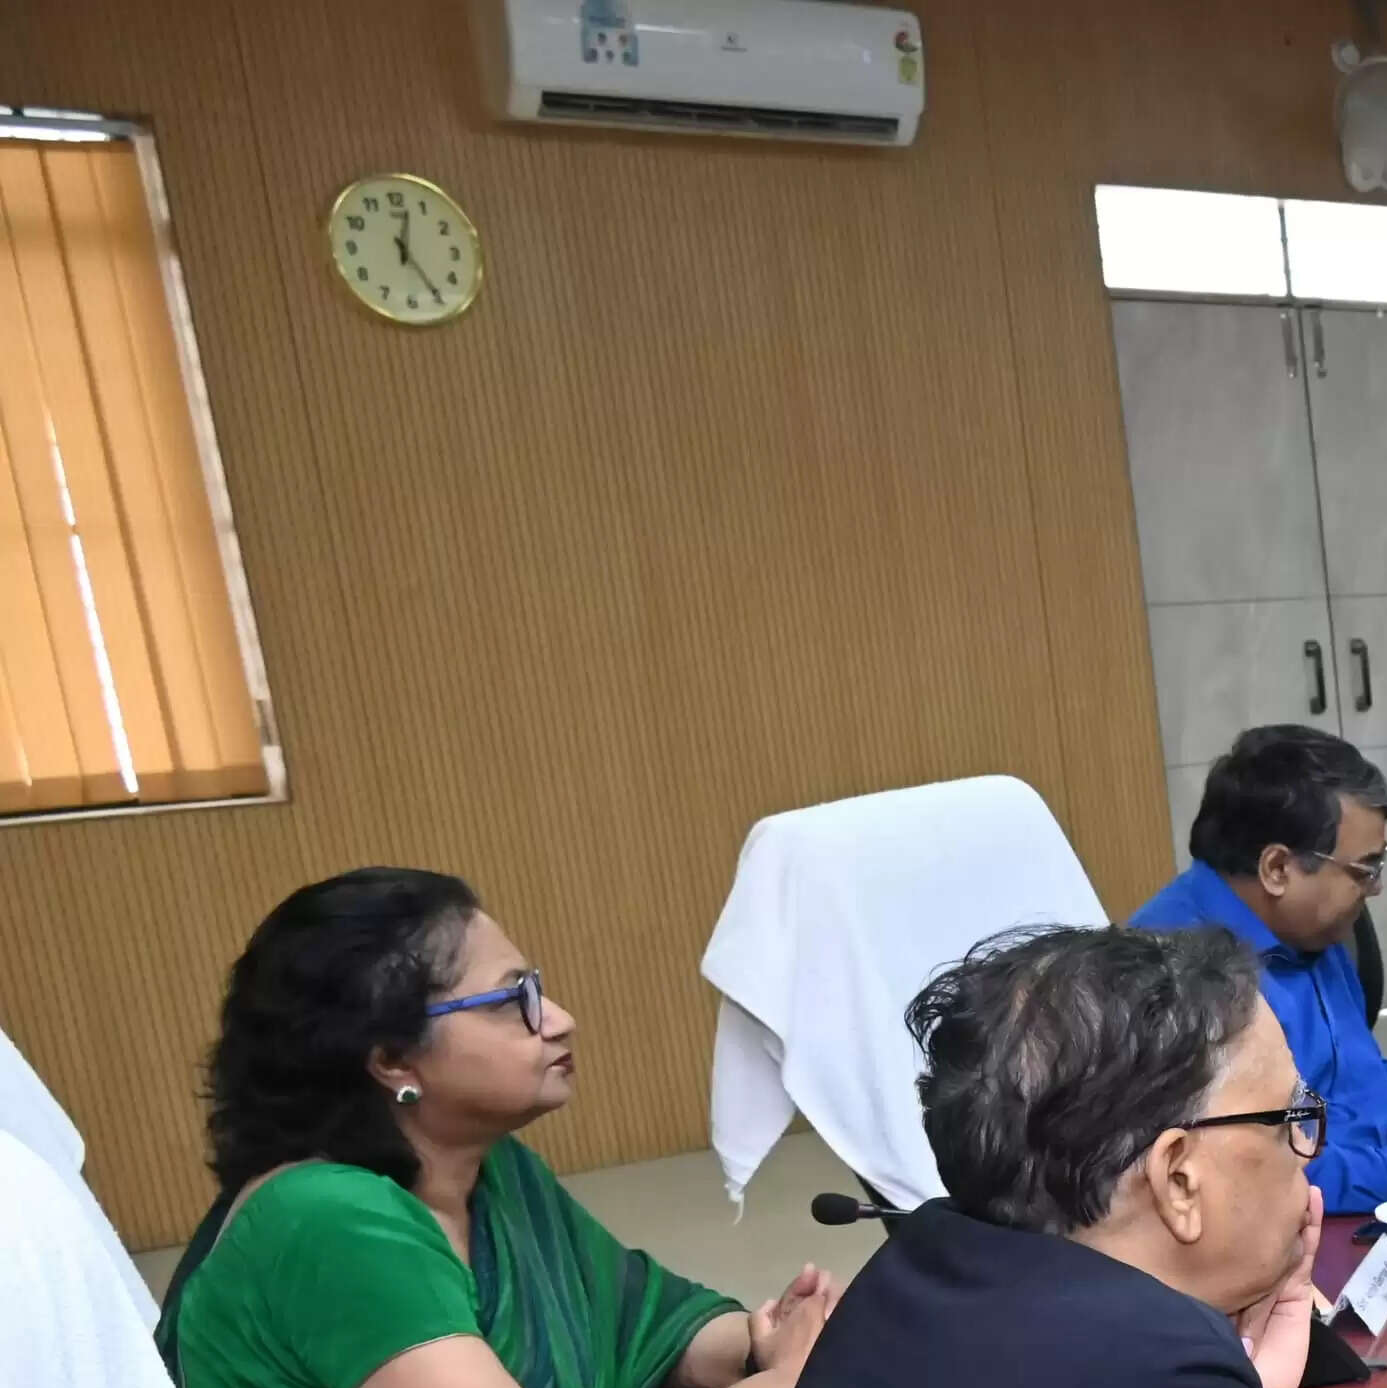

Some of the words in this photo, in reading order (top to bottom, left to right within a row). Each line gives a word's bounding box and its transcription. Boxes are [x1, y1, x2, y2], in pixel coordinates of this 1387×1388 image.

[363, 197, 379, 212] 11
[418, 200, 427, 216] 1
[346, 215, 365, 231] 10
[438, 220, 449, 236] 2
[449, 246, 460, 261] 3
[380, 285, 390, 300] 7
